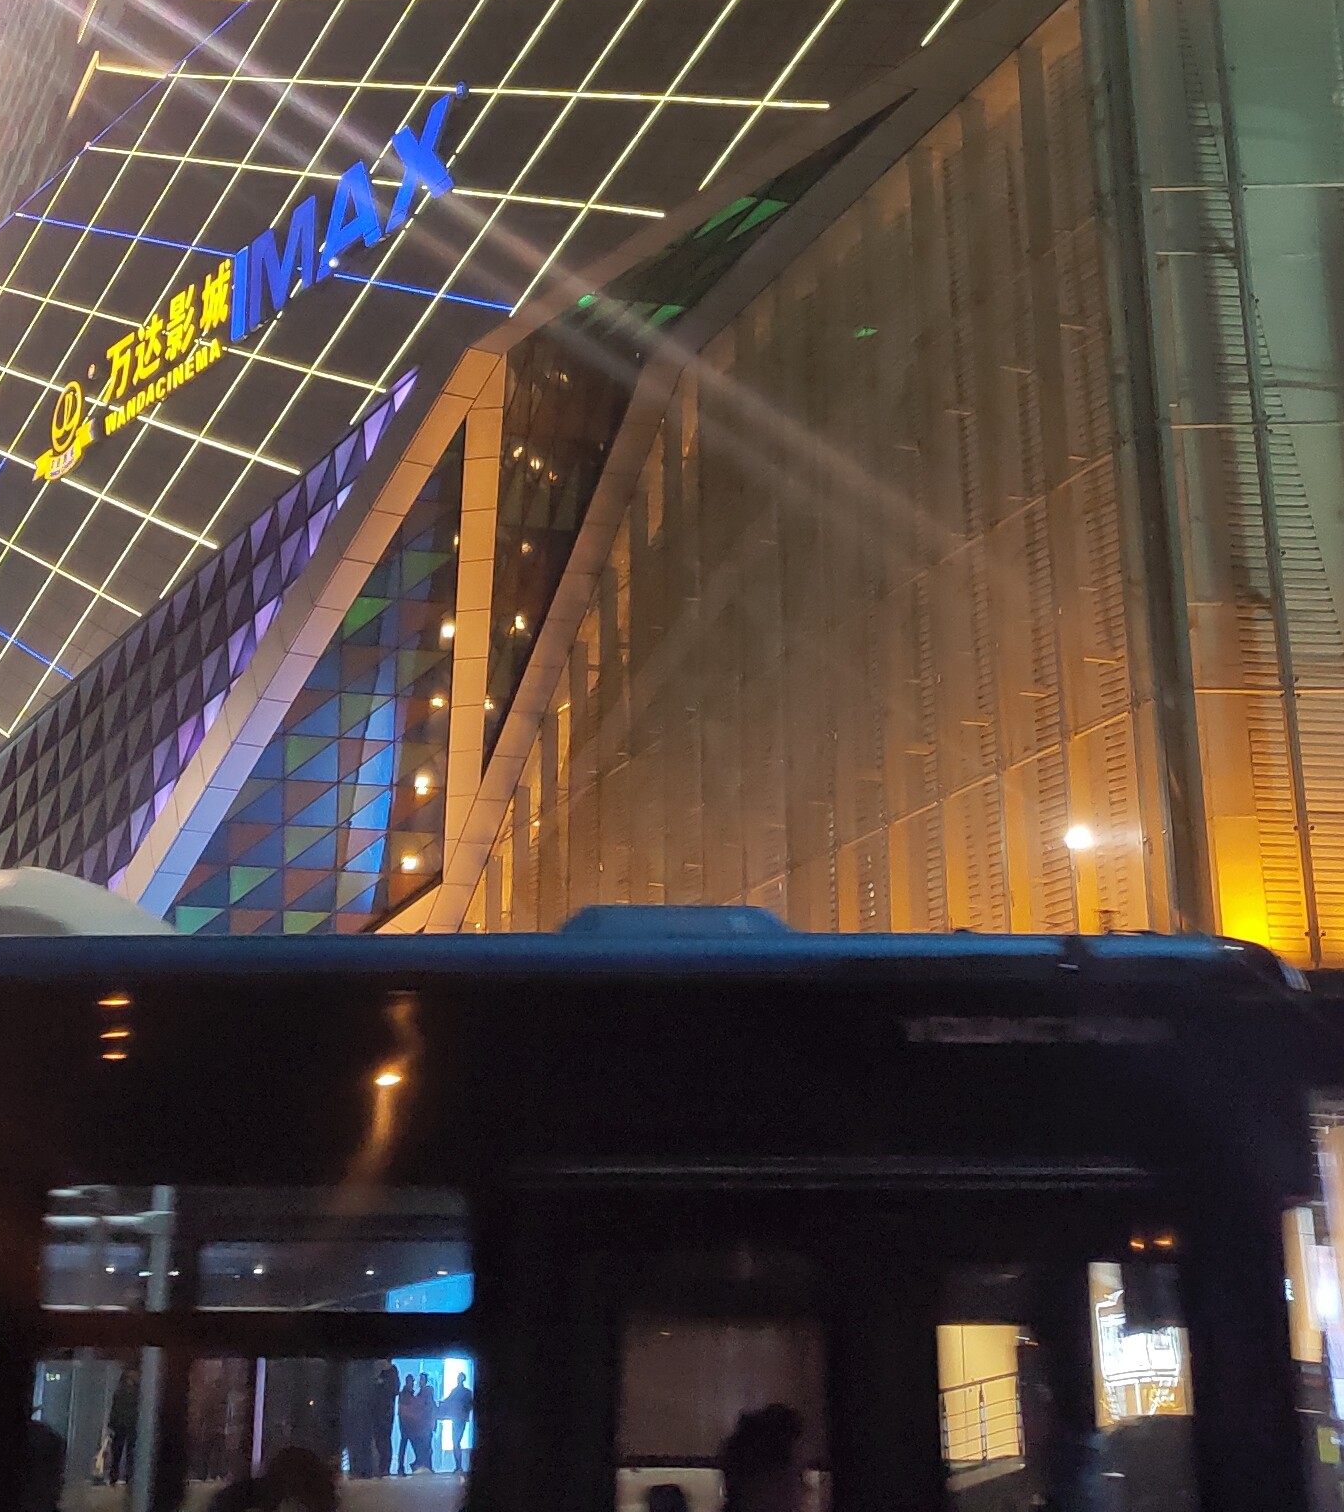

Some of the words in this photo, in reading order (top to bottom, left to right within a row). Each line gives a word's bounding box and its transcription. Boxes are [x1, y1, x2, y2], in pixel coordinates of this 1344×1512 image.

[229, 93, 454, 342] IMAX
[102, 259, 231, 403] 万达影城
